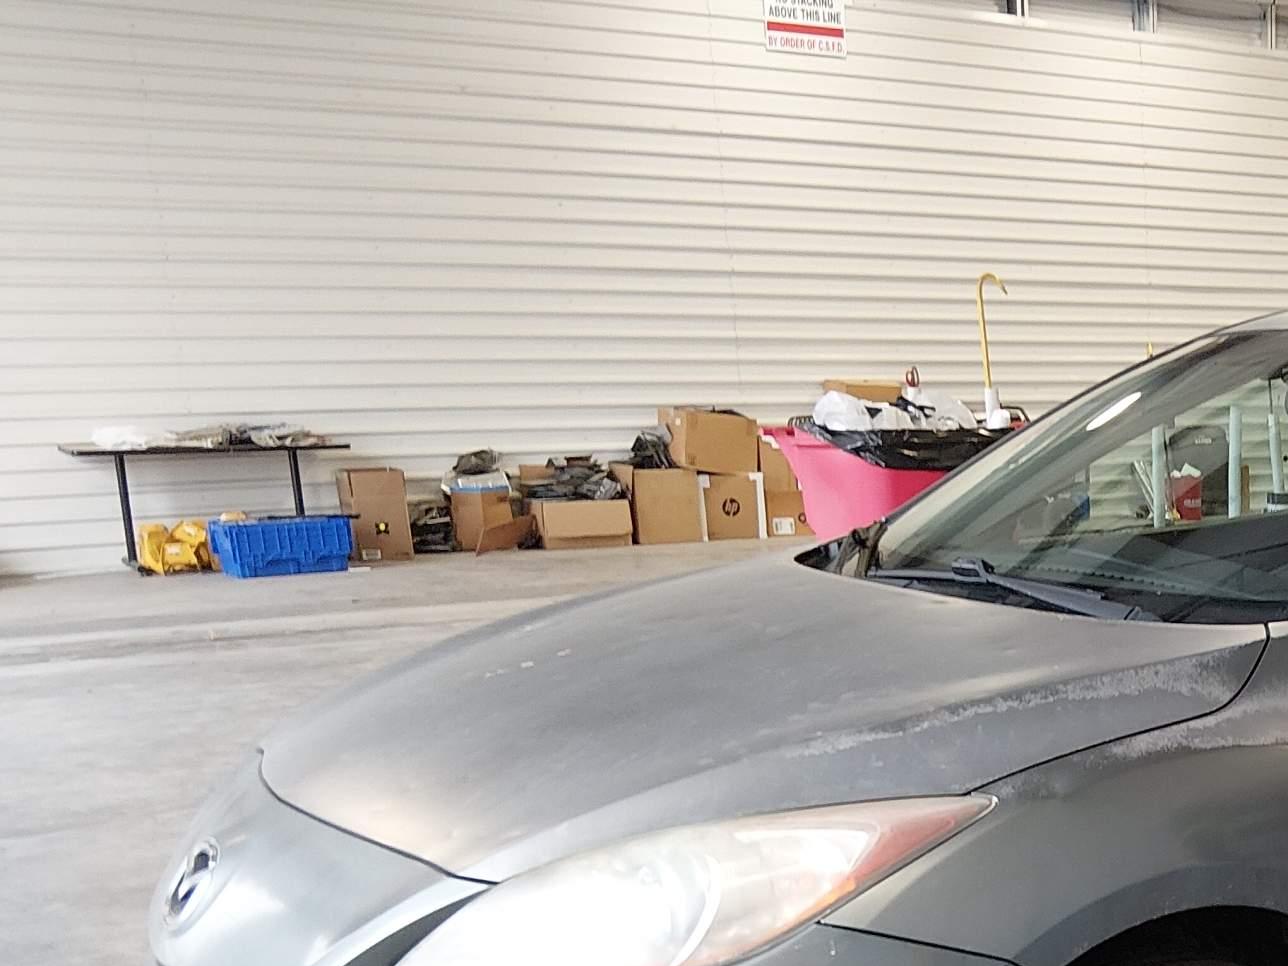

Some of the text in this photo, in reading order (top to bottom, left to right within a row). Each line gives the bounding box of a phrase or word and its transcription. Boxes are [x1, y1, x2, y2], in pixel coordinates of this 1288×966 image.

[769, 5, 841, 24] ABOVE THIS LINE
[768, 36, 778, 47] BY
[780, 37, 805, 50] ORDER
